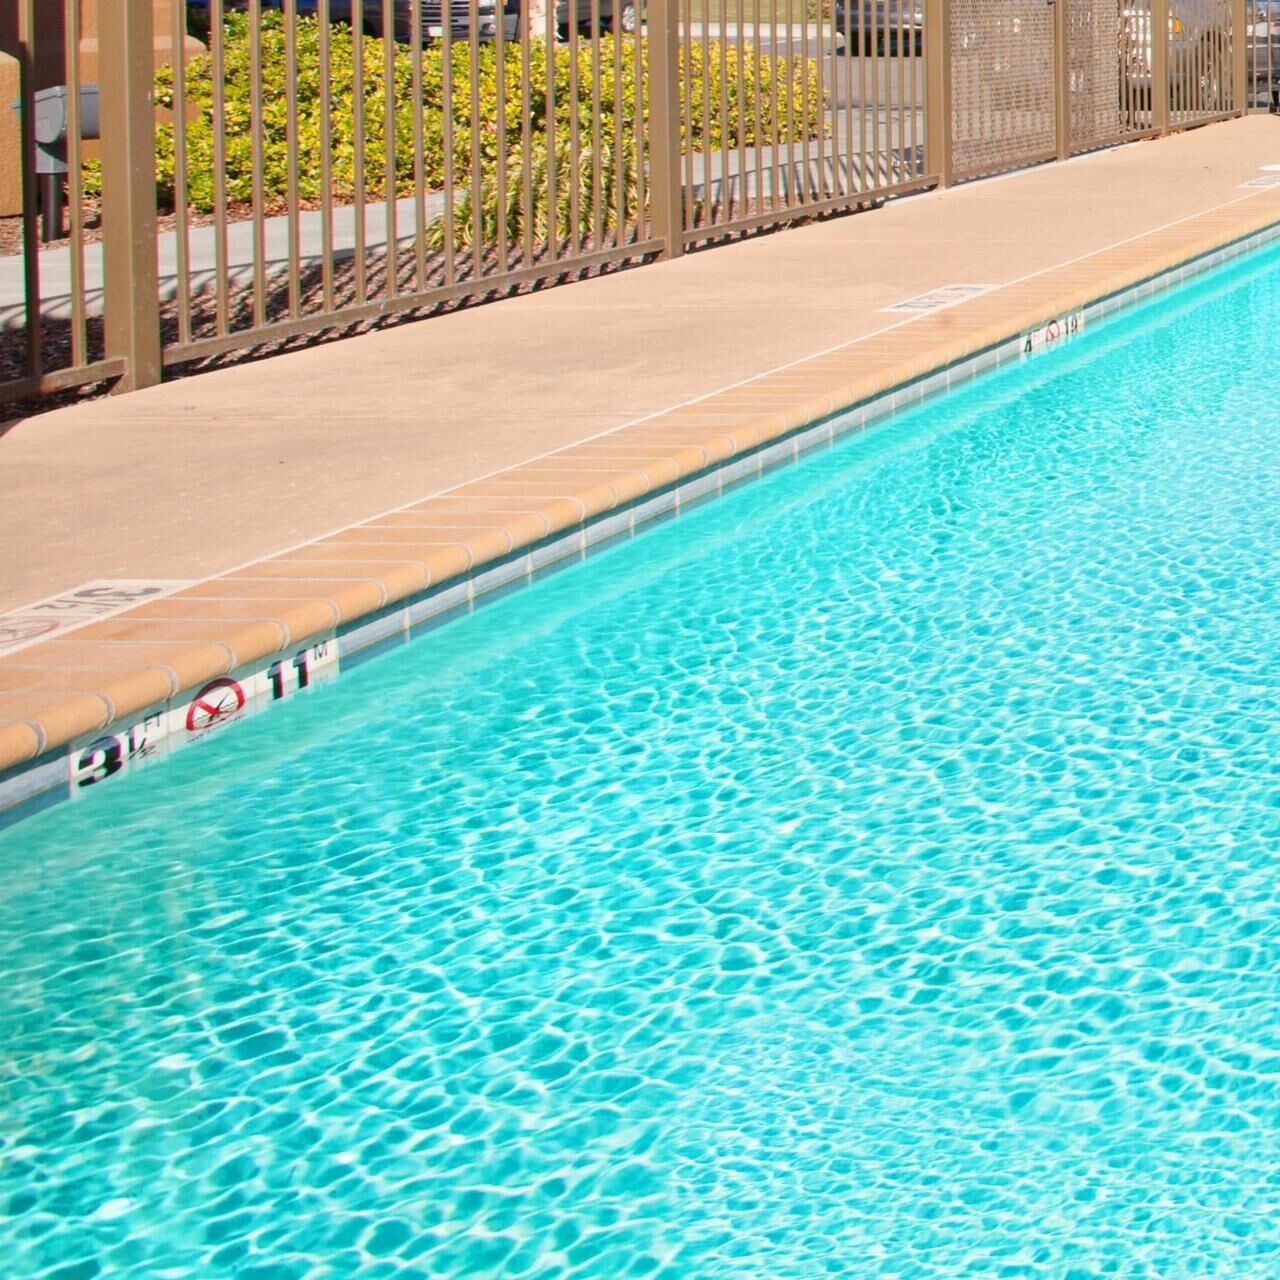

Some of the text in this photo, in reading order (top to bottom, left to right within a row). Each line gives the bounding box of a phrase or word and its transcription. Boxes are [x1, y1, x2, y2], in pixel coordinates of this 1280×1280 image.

[77, 734, 123, 788] 3
[144, 710, 164, 733] FT
[314, 639, 328, 662] M
